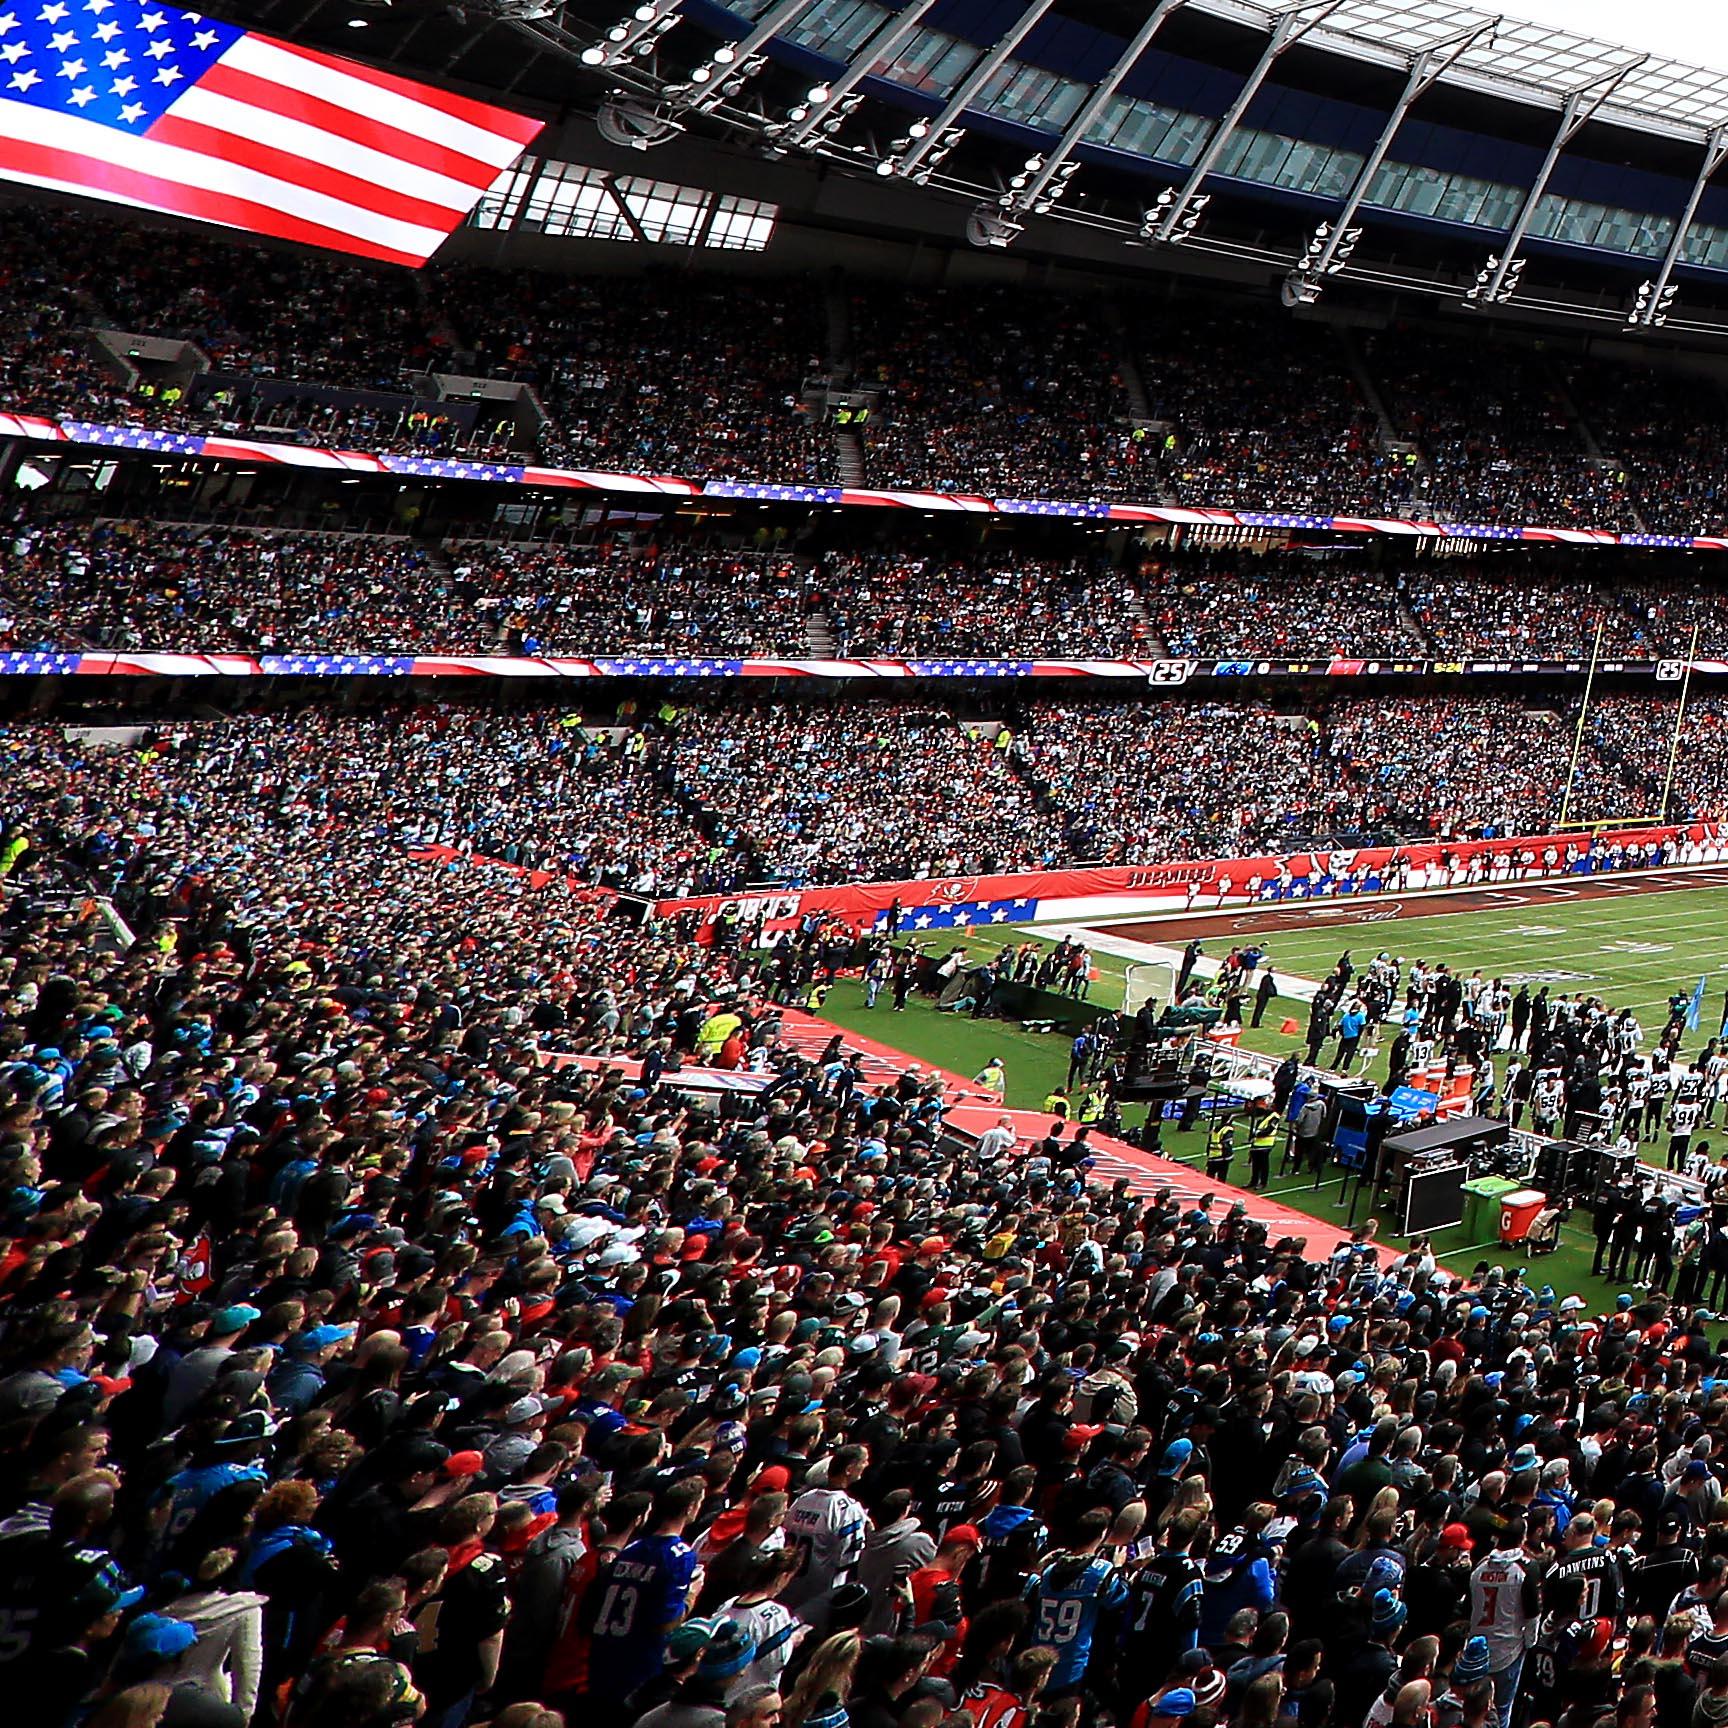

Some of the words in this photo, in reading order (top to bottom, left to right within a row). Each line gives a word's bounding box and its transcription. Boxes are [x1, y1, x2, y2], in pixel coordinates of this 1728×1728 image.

[1155, 663, 1183, 681] 25
[1257, 662, 1270, 674] 0
[1368, 662, 1380, 674] 0
[1433, 663, 1462, 673] 5:24
[1660, 662, 1679, 678] 25
[1414, 1047, 1428, 1060] 13
[1652, 1080, 1667, 1093] 23
[1540, 1095, 1555, 1108] 59
[1677, 1111, 1695, 1125] 94
[1501, 1211, 1513, 1231] G
[1215, 1533, 1243, 1553] 59
[1559, 1557, 1606, 1579] DAWKINS
[598, 1584, 638, 1637] 13
[1134, 1590, 1155, 1631] 7
[1038, 1599, 1084, 1644] 59
